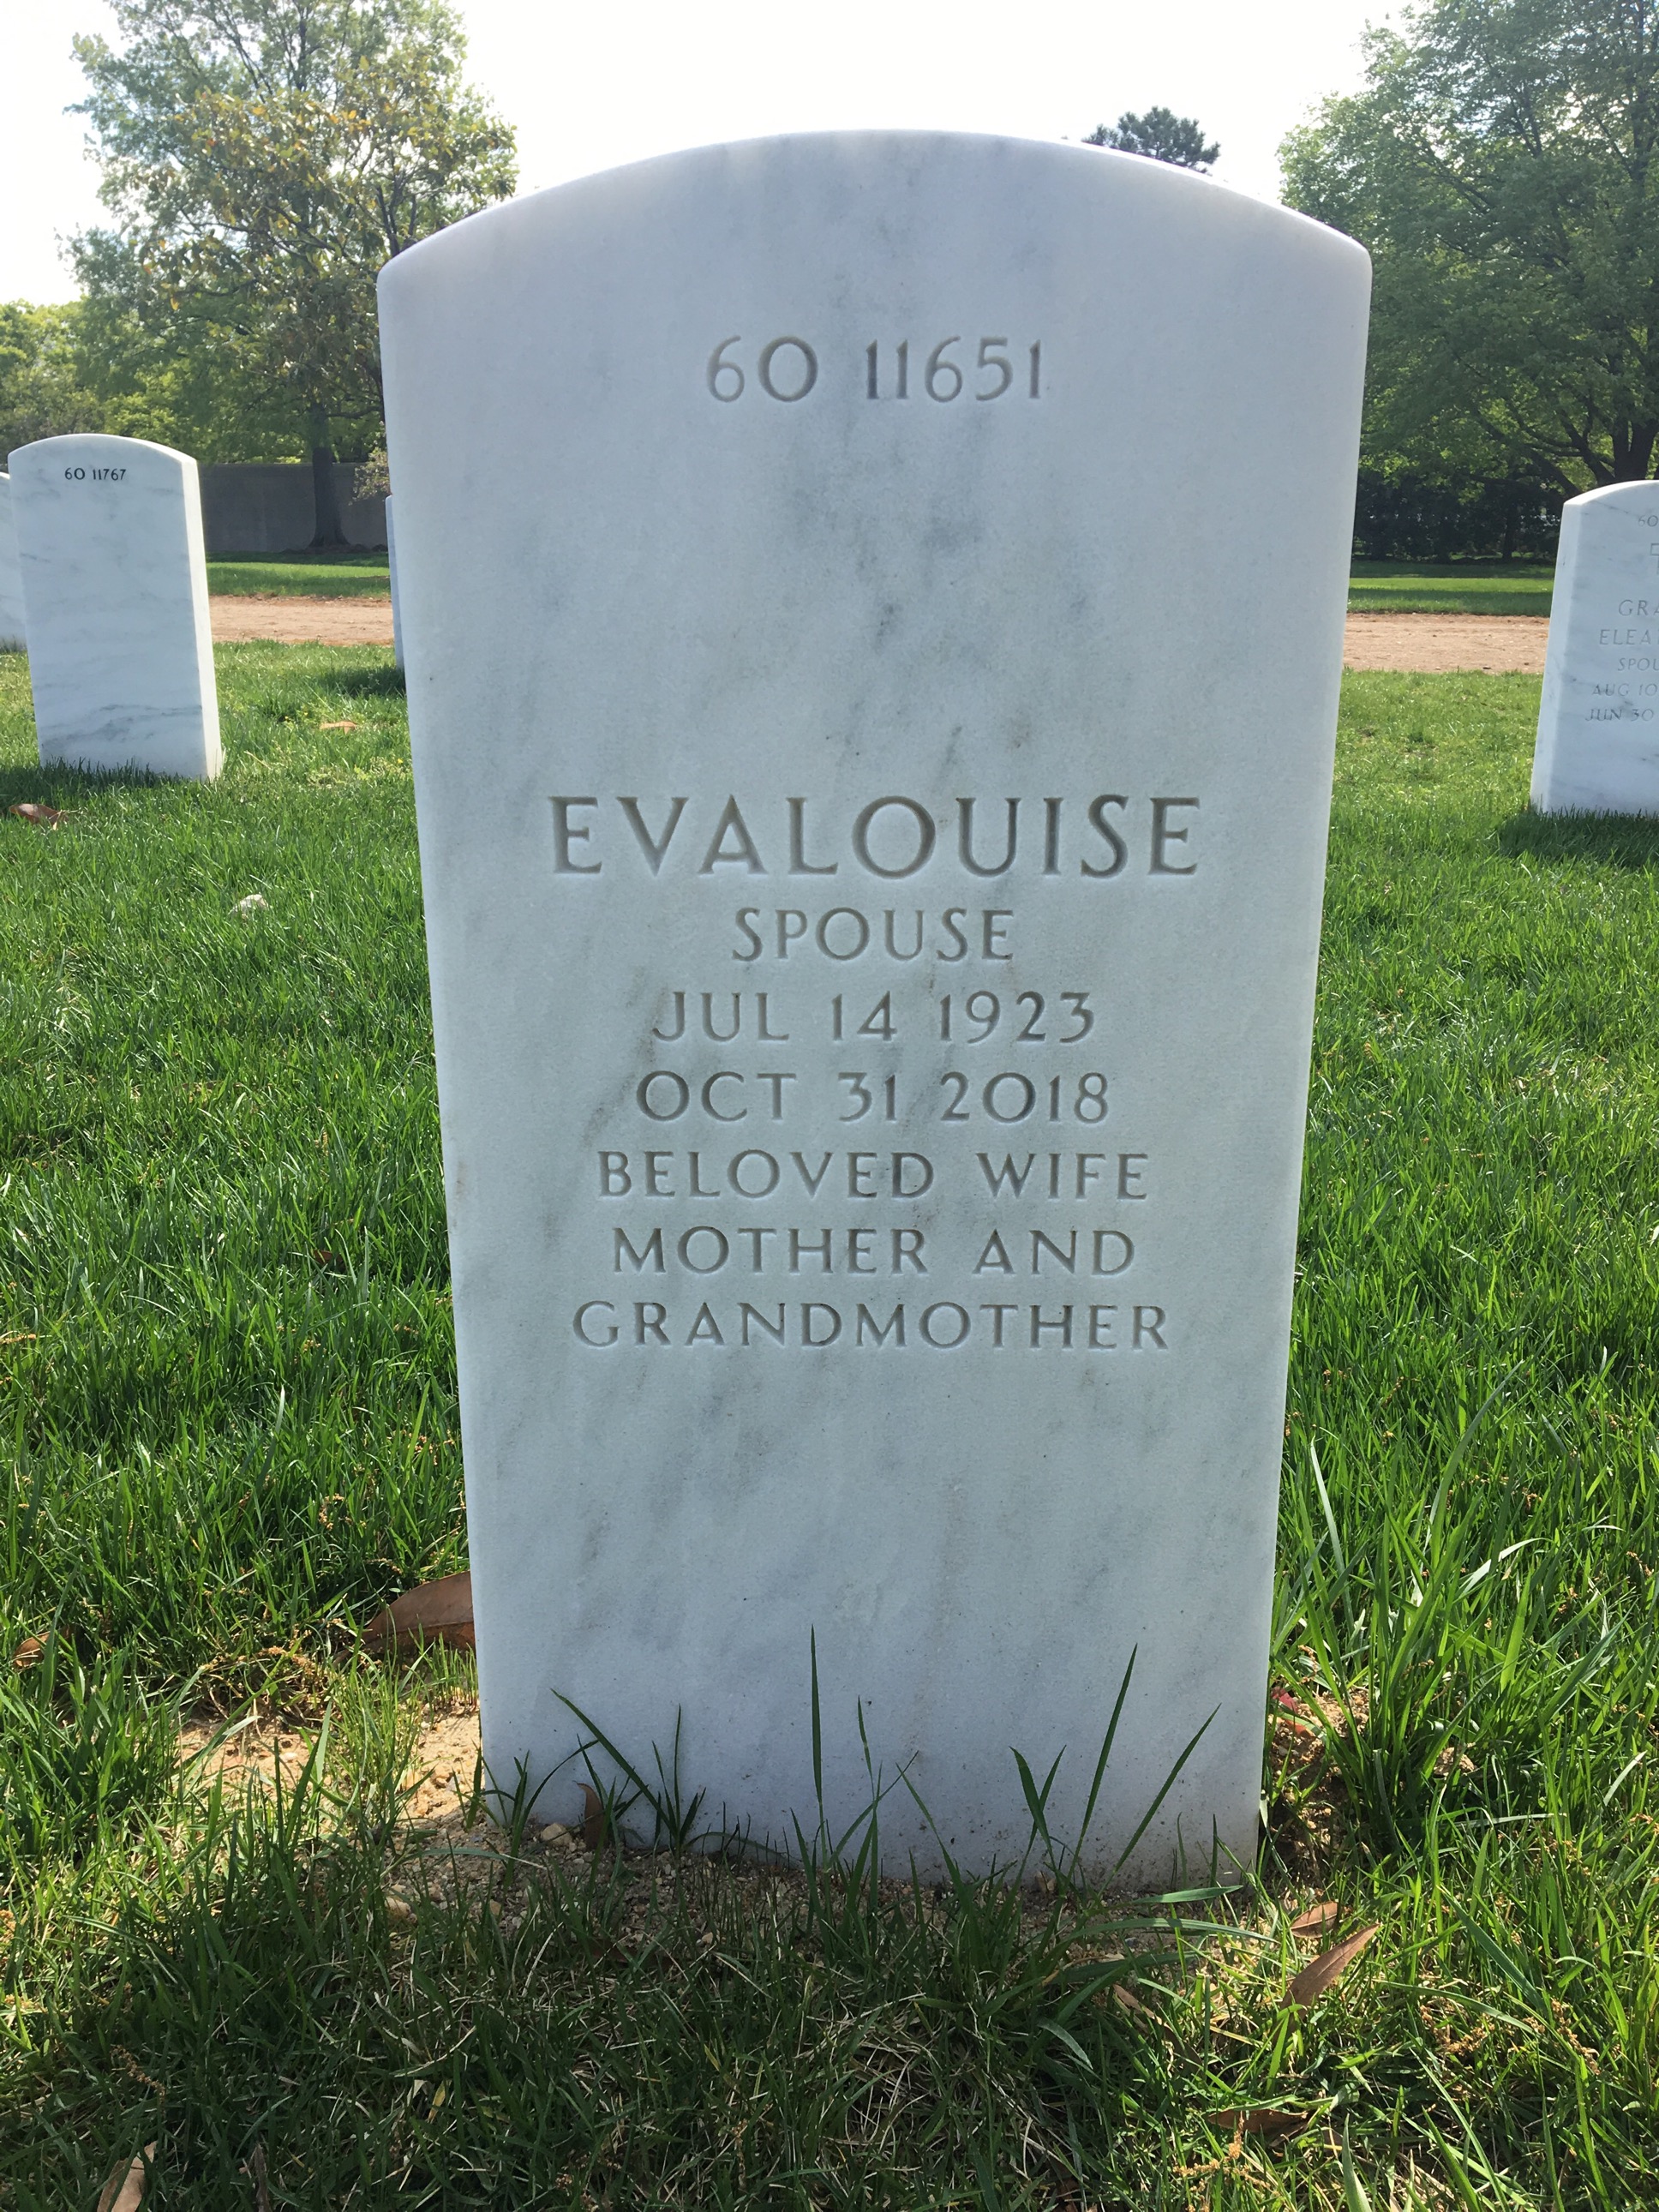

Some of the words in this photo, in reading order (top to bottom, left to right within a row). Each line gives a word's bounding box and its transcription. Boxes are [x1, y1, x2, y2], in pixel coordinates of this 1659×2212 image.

[706, 335, 818, 403] 60
[865, 335, 1041, 403] 11651
[64, 467, 86, 481] 60
[93, 468, 127, 482] 11767
[1638, 514, 1659, 527] 60
[1599, 629, 1659, 645] ELEA
[1584, 709, 1622, 721] JUN
[1630, 708, 1654, 721] 30
[1592, 683, 1629, 696] AUG
[1638, 683, 1657, 696] 10
[548, 794, 1200, 879] EVALOUISE
[732, 907, 1015, 962] SPOUSE
[652, 991, 790, 1042] JUL
[830, 991, 896, 1041] 14
[939, 990, 1095, 1044] 1923
[636, 1070, 797, 1123] OCT
[837, 1072, 897, 1122] 31
[940, 1071, 1110, 1124] 2018
[598, 1148, 935, 1200] BELOVED
[977, 1152, 1150, 1200] WIFE
[613, 1226, 927, 1275] MOTHER
[973, 1228, 1135, 1276] AND
[572, 1300, 1170, 1350] GRANDMOTHER
